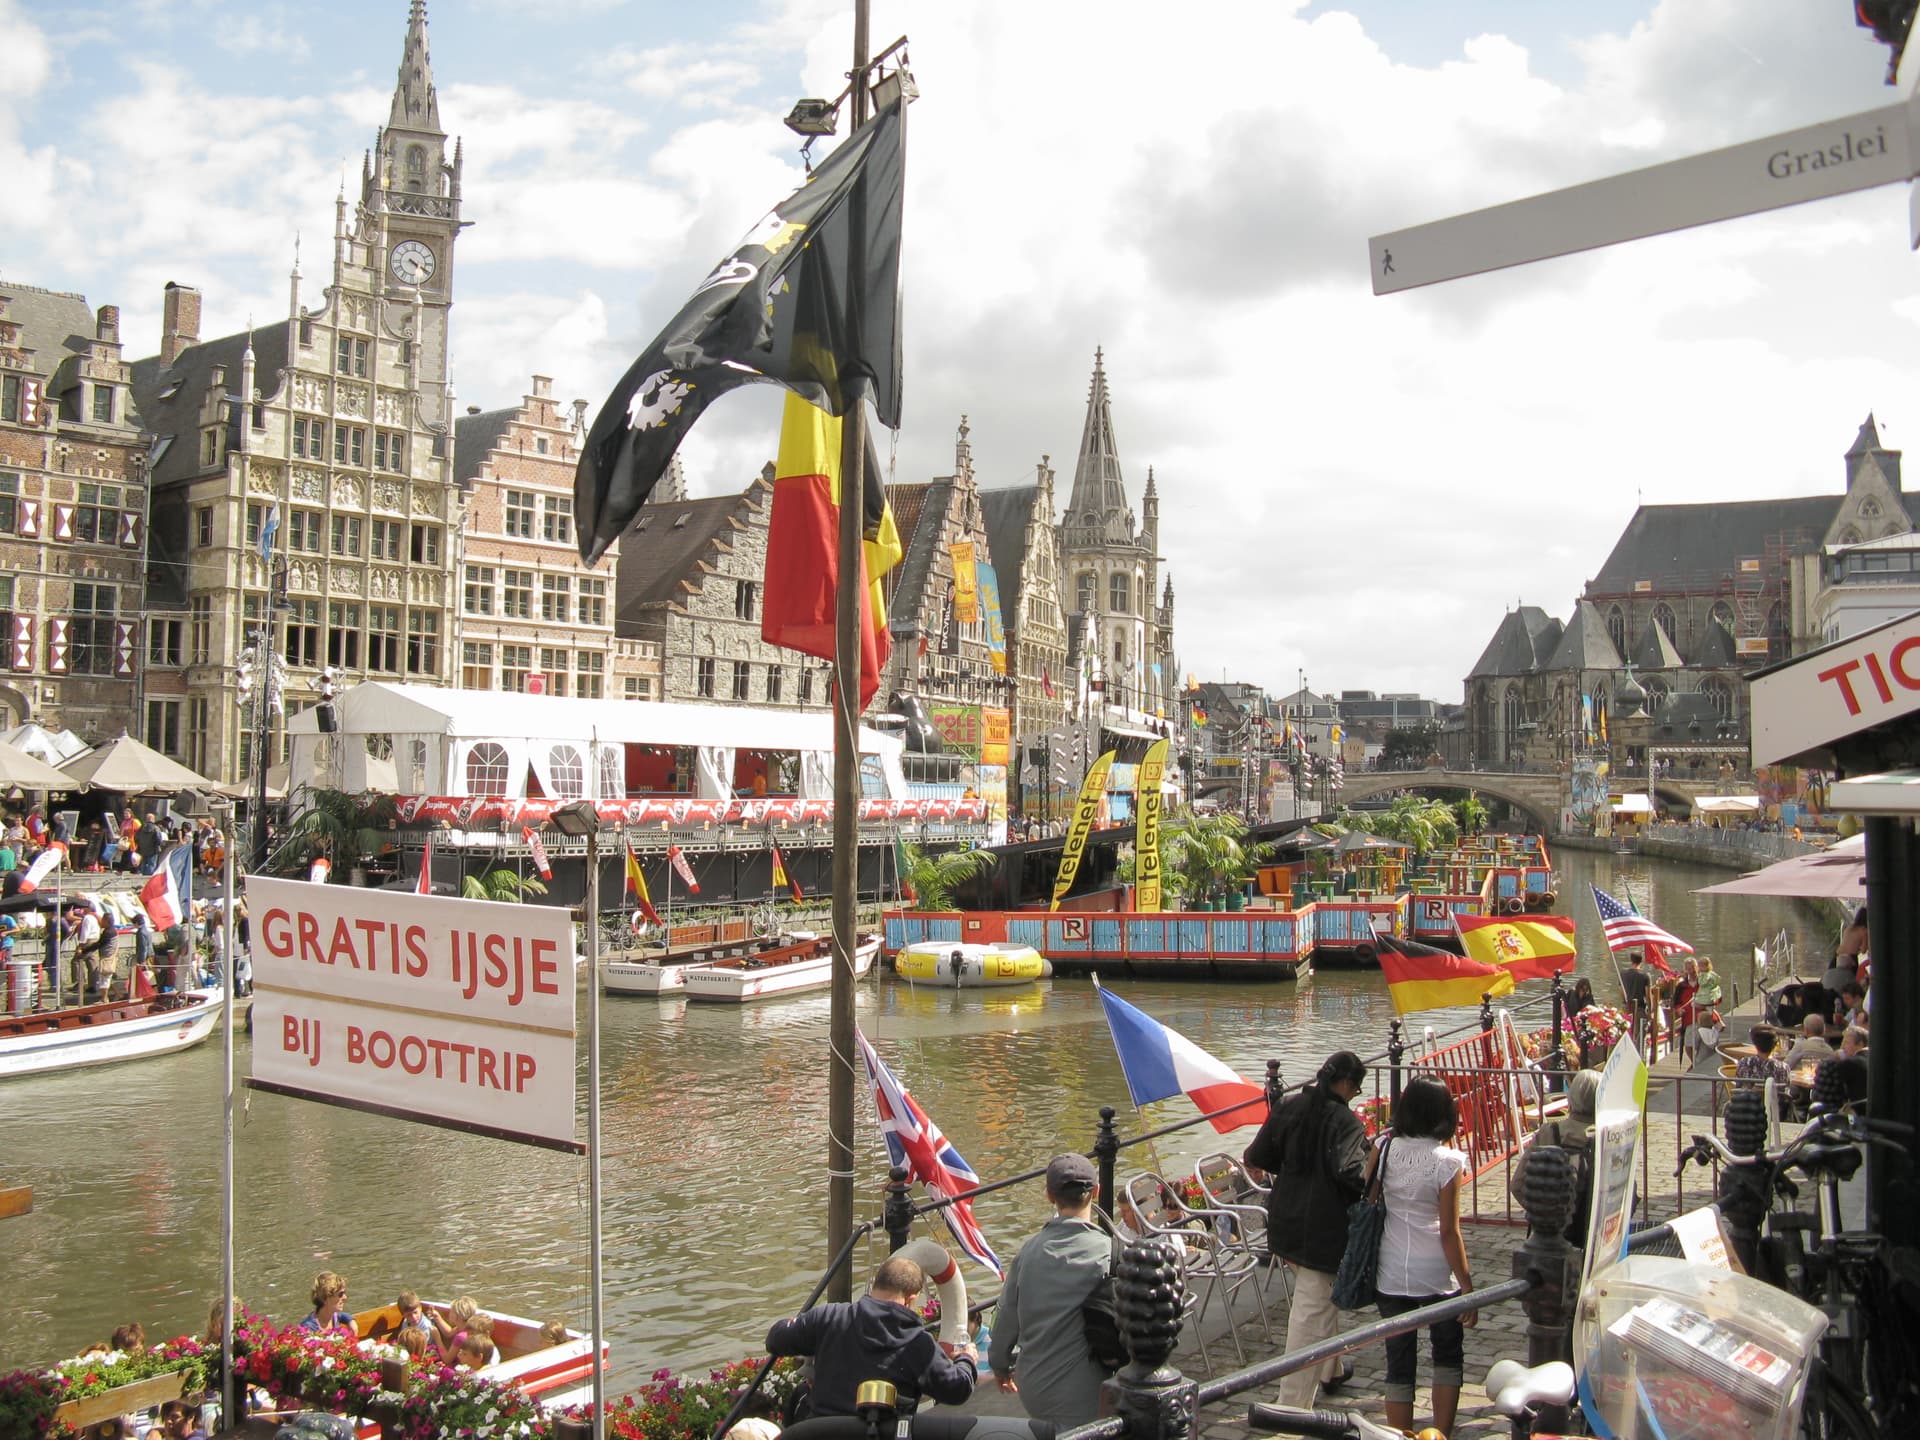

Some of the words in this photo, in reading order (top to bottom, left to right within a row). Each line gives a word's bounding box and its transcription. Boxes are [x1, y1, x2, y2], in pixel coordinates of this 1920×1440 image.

[1767, 125, 1887, 179] Graslei
[934, 713, 976, 727] POLE
[940, 728, 976, 742] OLE
[1056, 795, 1098, 886] telenet
[1138, 786, 1160, 882] telenet
[262, 908, 428, 977] GRATIS
[450, 929, 558, 1006] IJSJE
[283, 1014, 321, 1066] BIJ
[347, 1026, 536, 1093] BOOTTRIP
